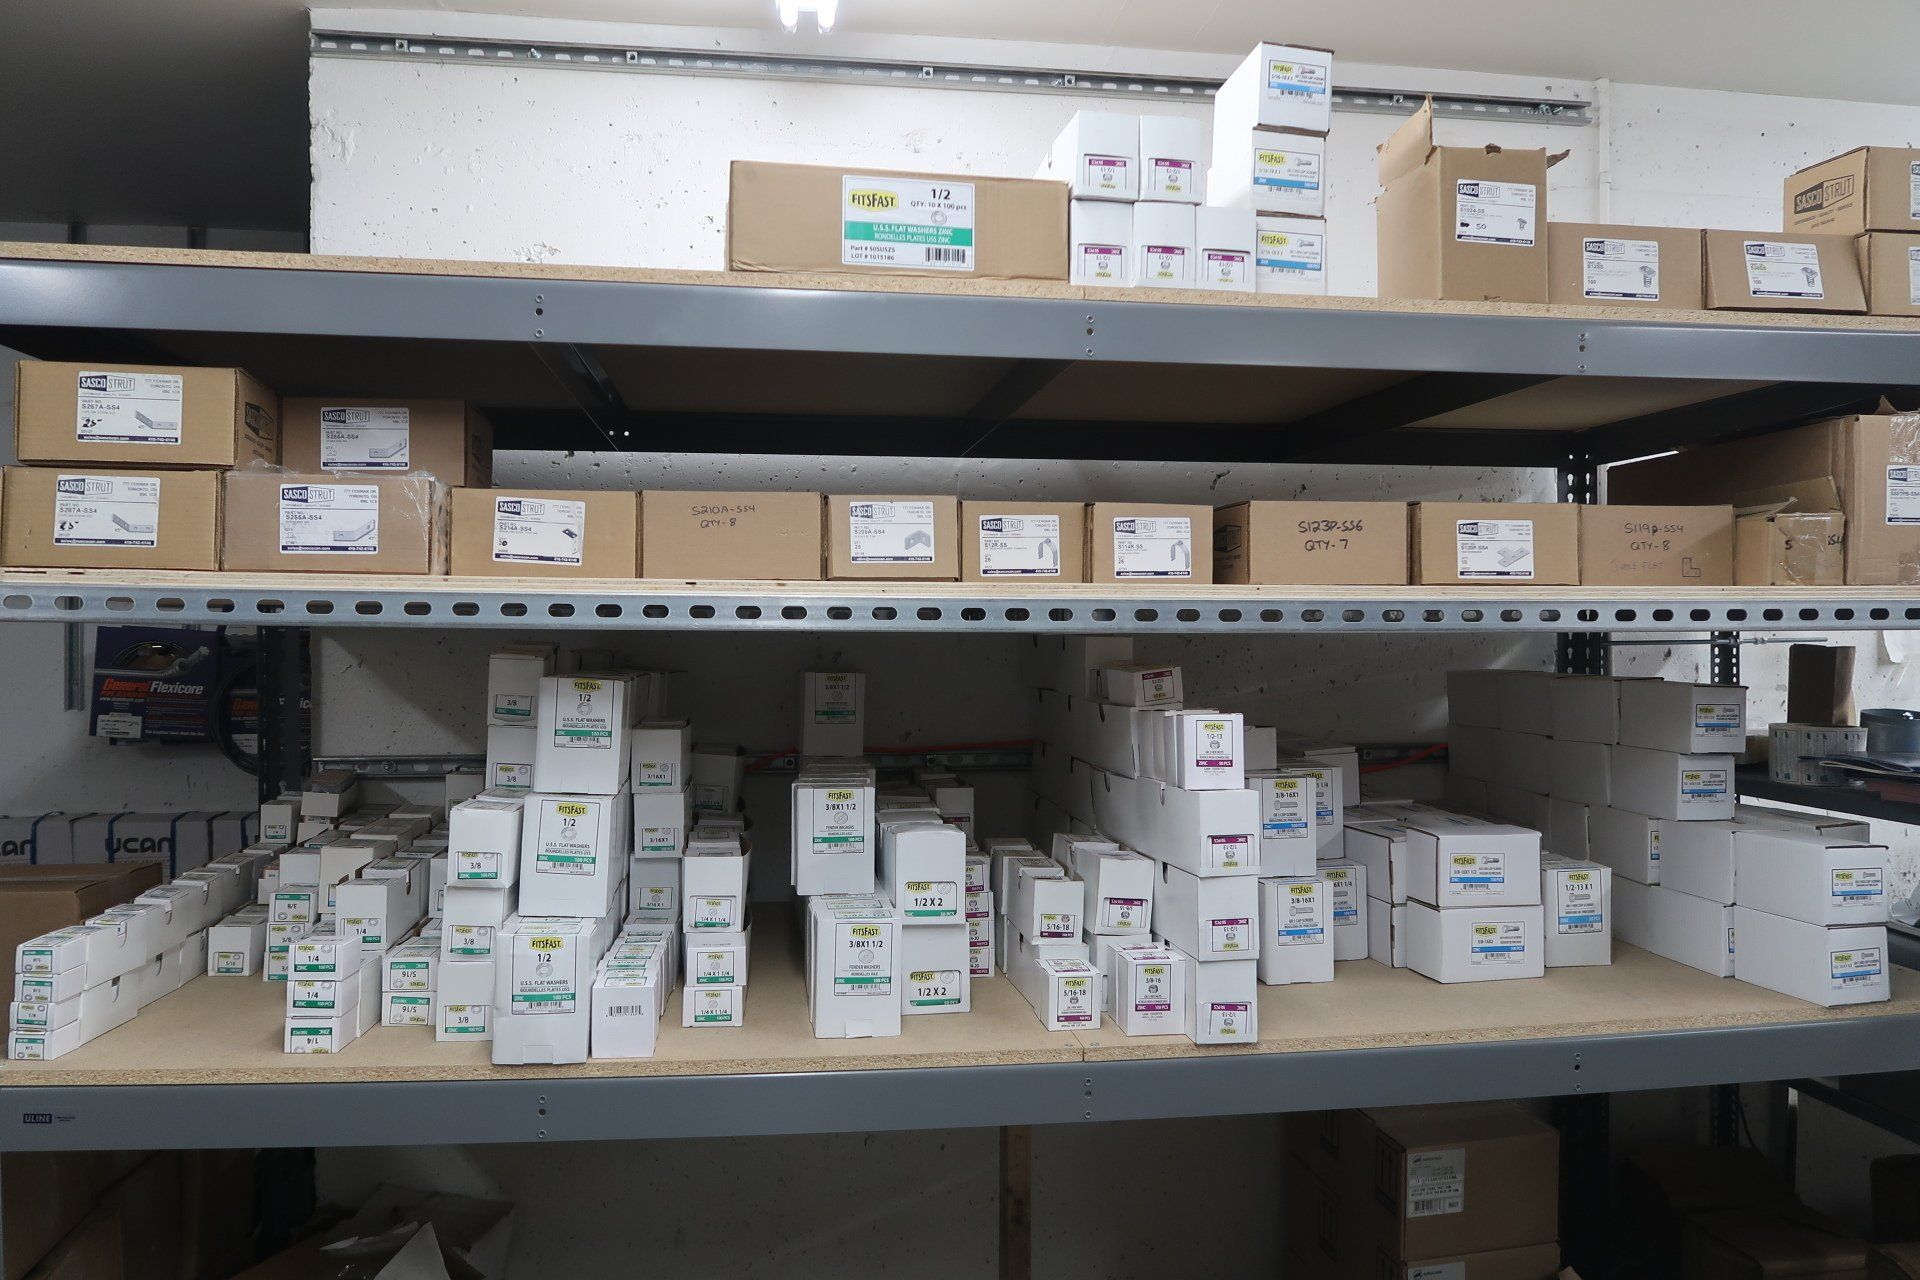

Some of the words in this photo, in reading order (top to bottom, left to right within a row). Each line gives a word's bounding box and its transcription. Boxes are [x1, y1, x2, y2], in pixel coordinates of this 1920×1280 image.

[1259, 154, 1284, 164] FITSFAST
[1460, 184, 1478, 194] SASCO
[931, 188, 951, 200] 1/2
[1796, 188, 1823, 212] SASCO
[1825, 178, 1852, 202] STRUT
[852, 193, 895, 207] FITSFAST
[908, 226, 938, 234] WASHERS
[874, 233, 906, 241] RONDELLES
[1262, 235, 1287, 245] FITSFAST
[81, 377, 106, 388] SASCO
[108, 380, 133, 390] STRUT
[324, 412, 346, 420] SASCO
[347, 412, 368, 420] STRUT
[60, 481, 84, 492] SASCO
[86, 482, 110, 493] STRUT
[284, 490, 307, 500] SASCO
[310, 490, 333, 500] STRUT
[500, 502, 520, 512] SASCO
[522, 504, 543, 514] STRUT
[852, 507, 872, 516] SASCO
[983, 520, 1002, 530] SASCO
[1004, 521, 1023, 530] STRUT
[1116, 522, 1135, 531] SASCO
[1136, 523, 1154, 531] STRUT
[150, 681, 204, 694] Flexicore
[578, 694, 592, 702] 1/2
[559, 806, 585, 814] FITSFAST
[563, 818, 576, 826] 1/2
[908, 883, 931, 891] FITSFAST
[914, 898, 928, 906] 1/2
[937, 898, 943, 906] 2
[852, 927, 878, 936] FITSFAST
[532, 938, 562, 949] FITSFAST
[537, 954, 552, 962] 1/2
[918, 988, 932, 996] 1/2
[941, 988, 946, 996] 2
[24, 1114, 52, 1123] ULINE
